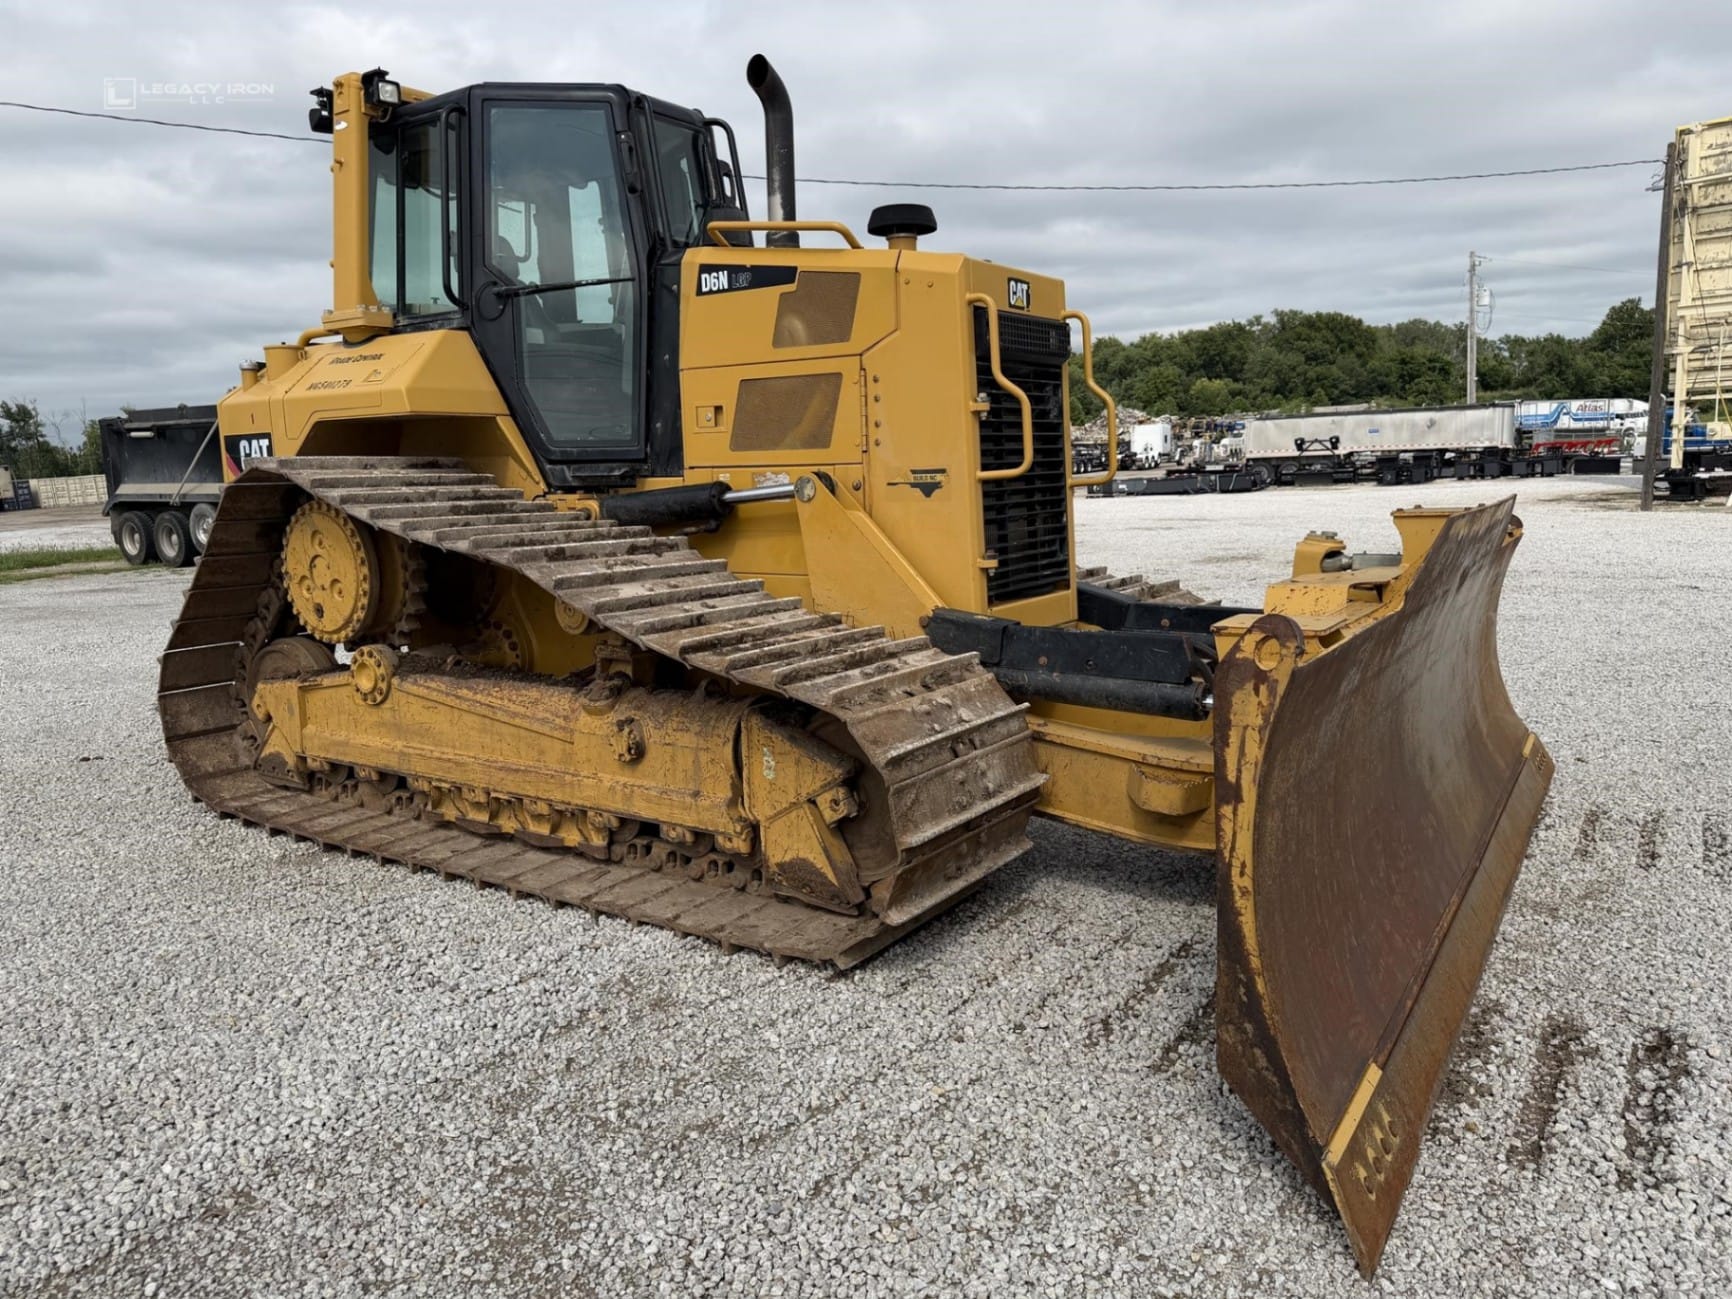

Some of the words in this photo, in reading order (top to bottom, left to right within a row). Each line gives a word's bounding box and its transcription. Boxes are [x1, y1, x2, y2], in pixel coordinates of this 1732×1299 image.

[700, 270, 729, 293] D6N
[731, 272, 753, 289] LGP
[1009, 280, 1028, 309] CAT
[1575, 403, 1604, 412] Atlas
[239, 438, 270, 471] CAT
